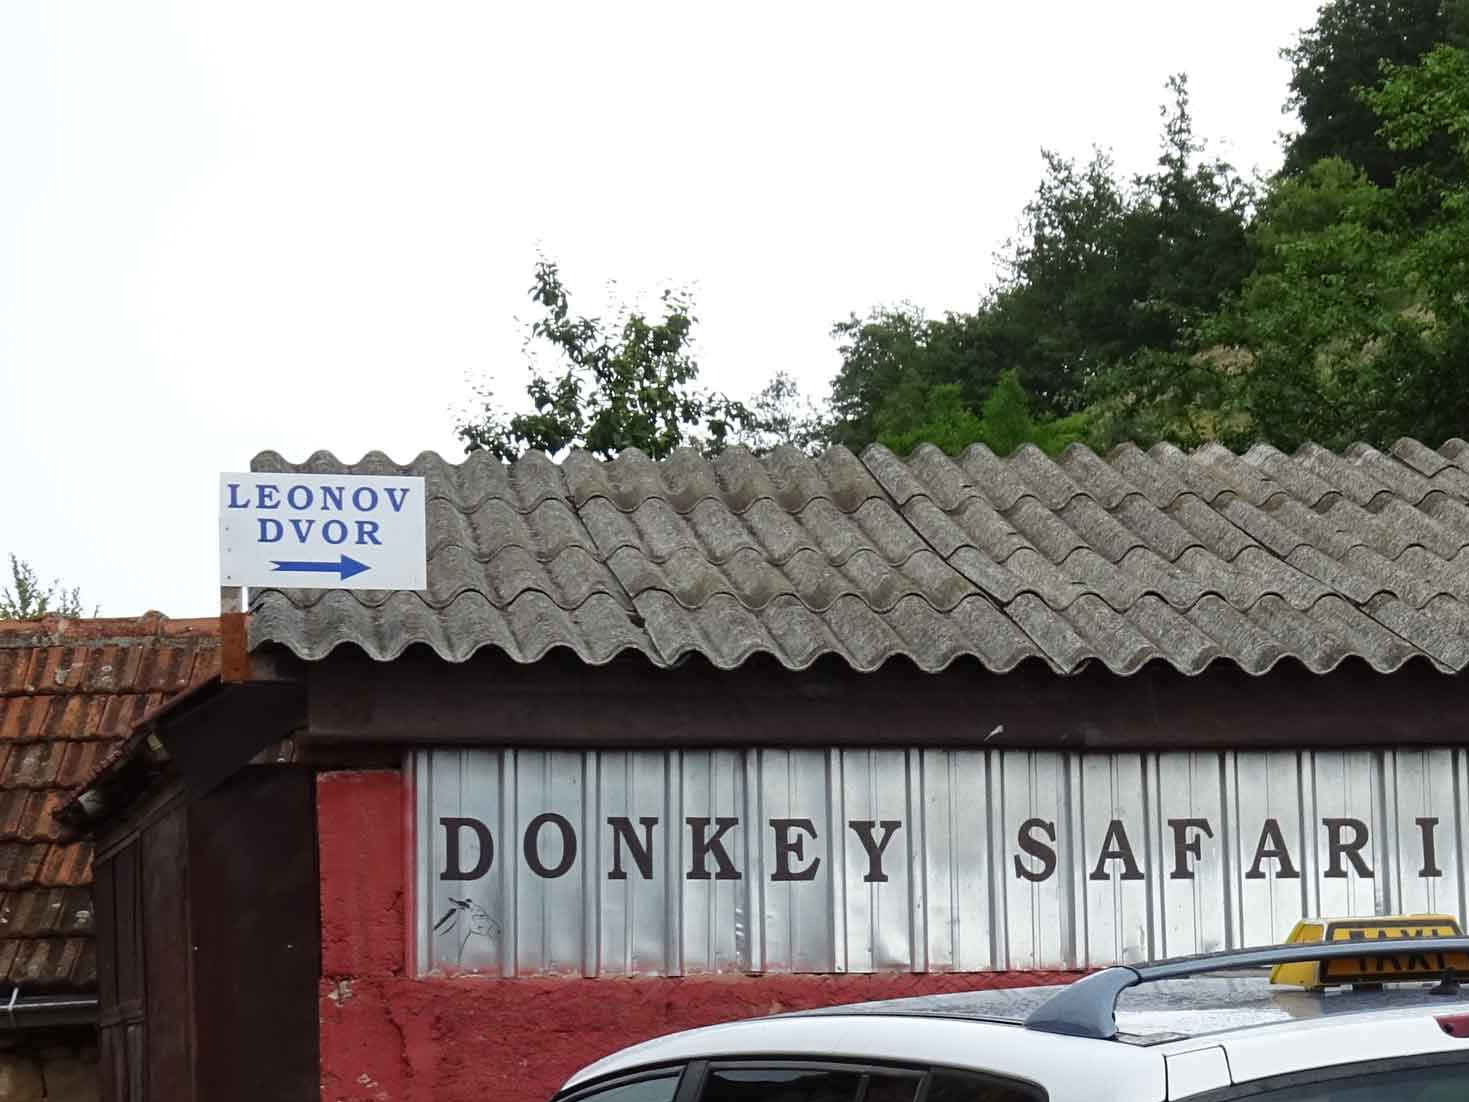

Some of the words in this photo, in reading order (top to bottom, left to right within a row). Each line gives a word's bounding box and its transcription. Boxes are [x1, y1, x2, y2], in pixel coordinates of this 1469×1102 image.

[227, 483, 410, 512] LEONOV
[257, 518, 382, 545] DVOR
[439, 812, 903, 883] DONKEY
[1014, 818, 1442, 882] SAFARI
